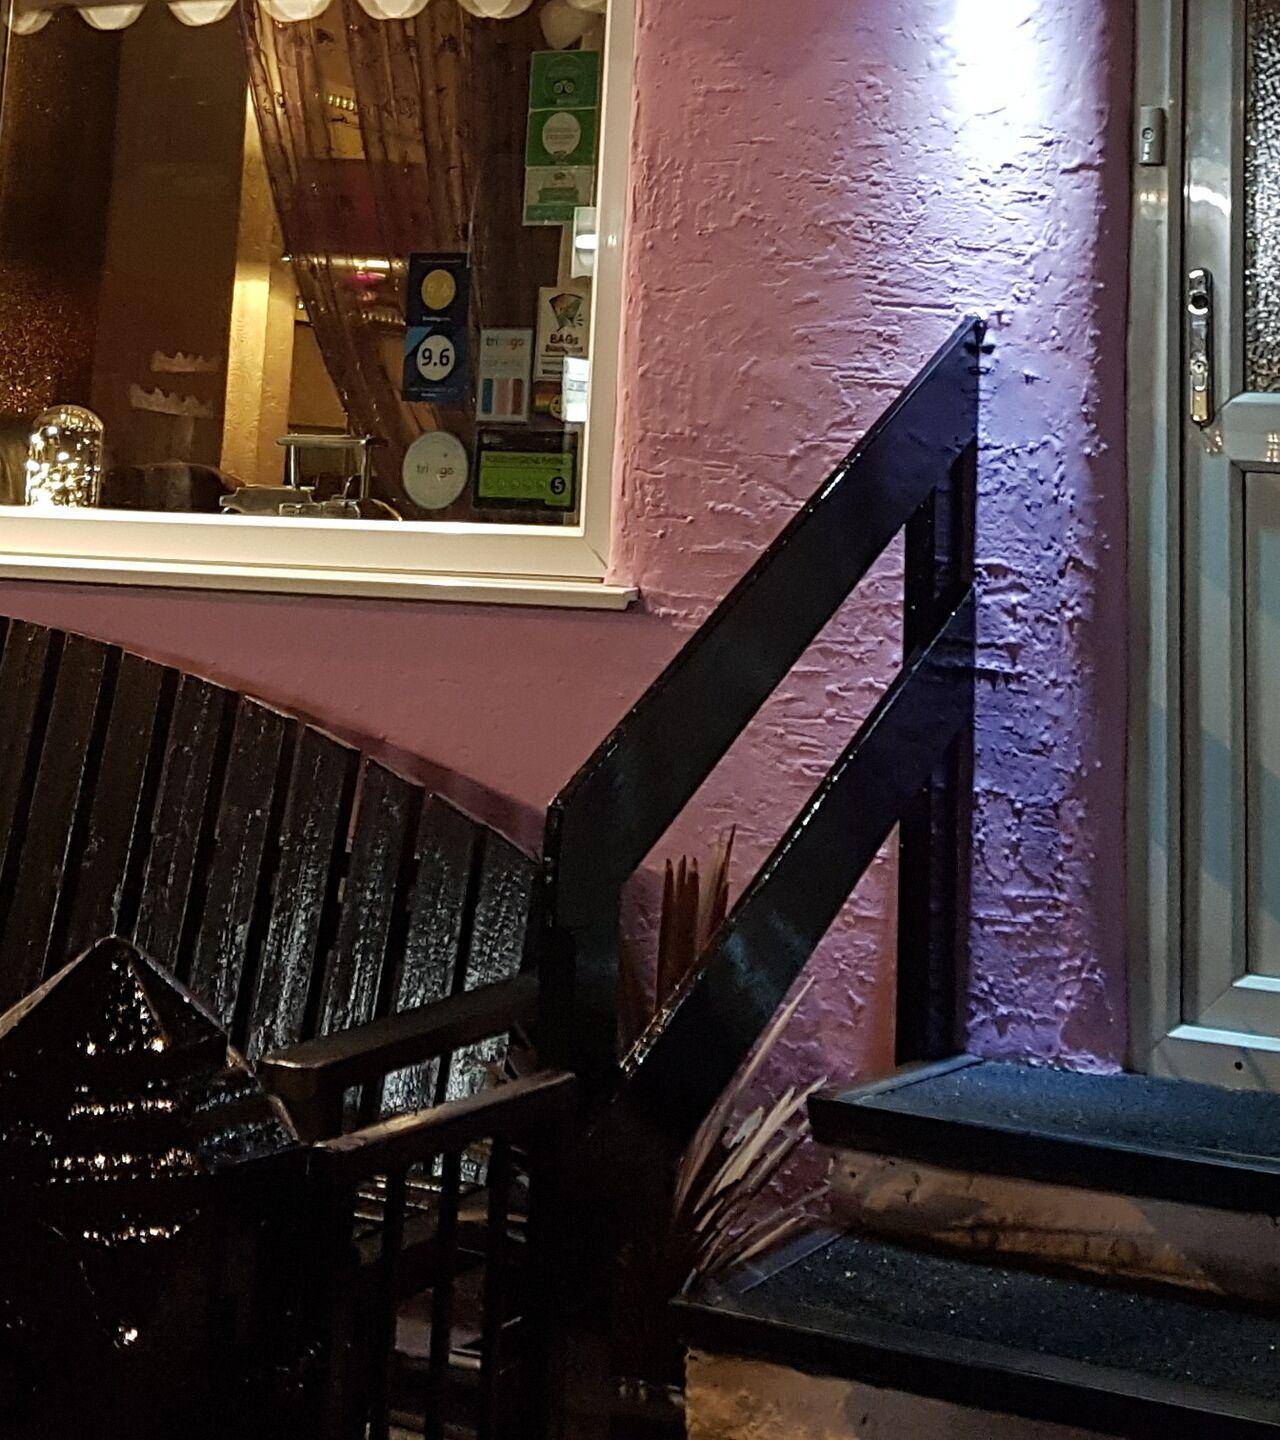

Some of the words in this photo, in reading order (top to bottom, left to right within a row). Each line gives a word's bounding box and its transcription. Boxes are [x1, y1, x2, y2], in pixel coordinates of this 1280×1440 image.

[486, 336, 524, 350] trigo
[422, 348, 450, 367] 9.6
[417, 464, 454, 478] trigo
